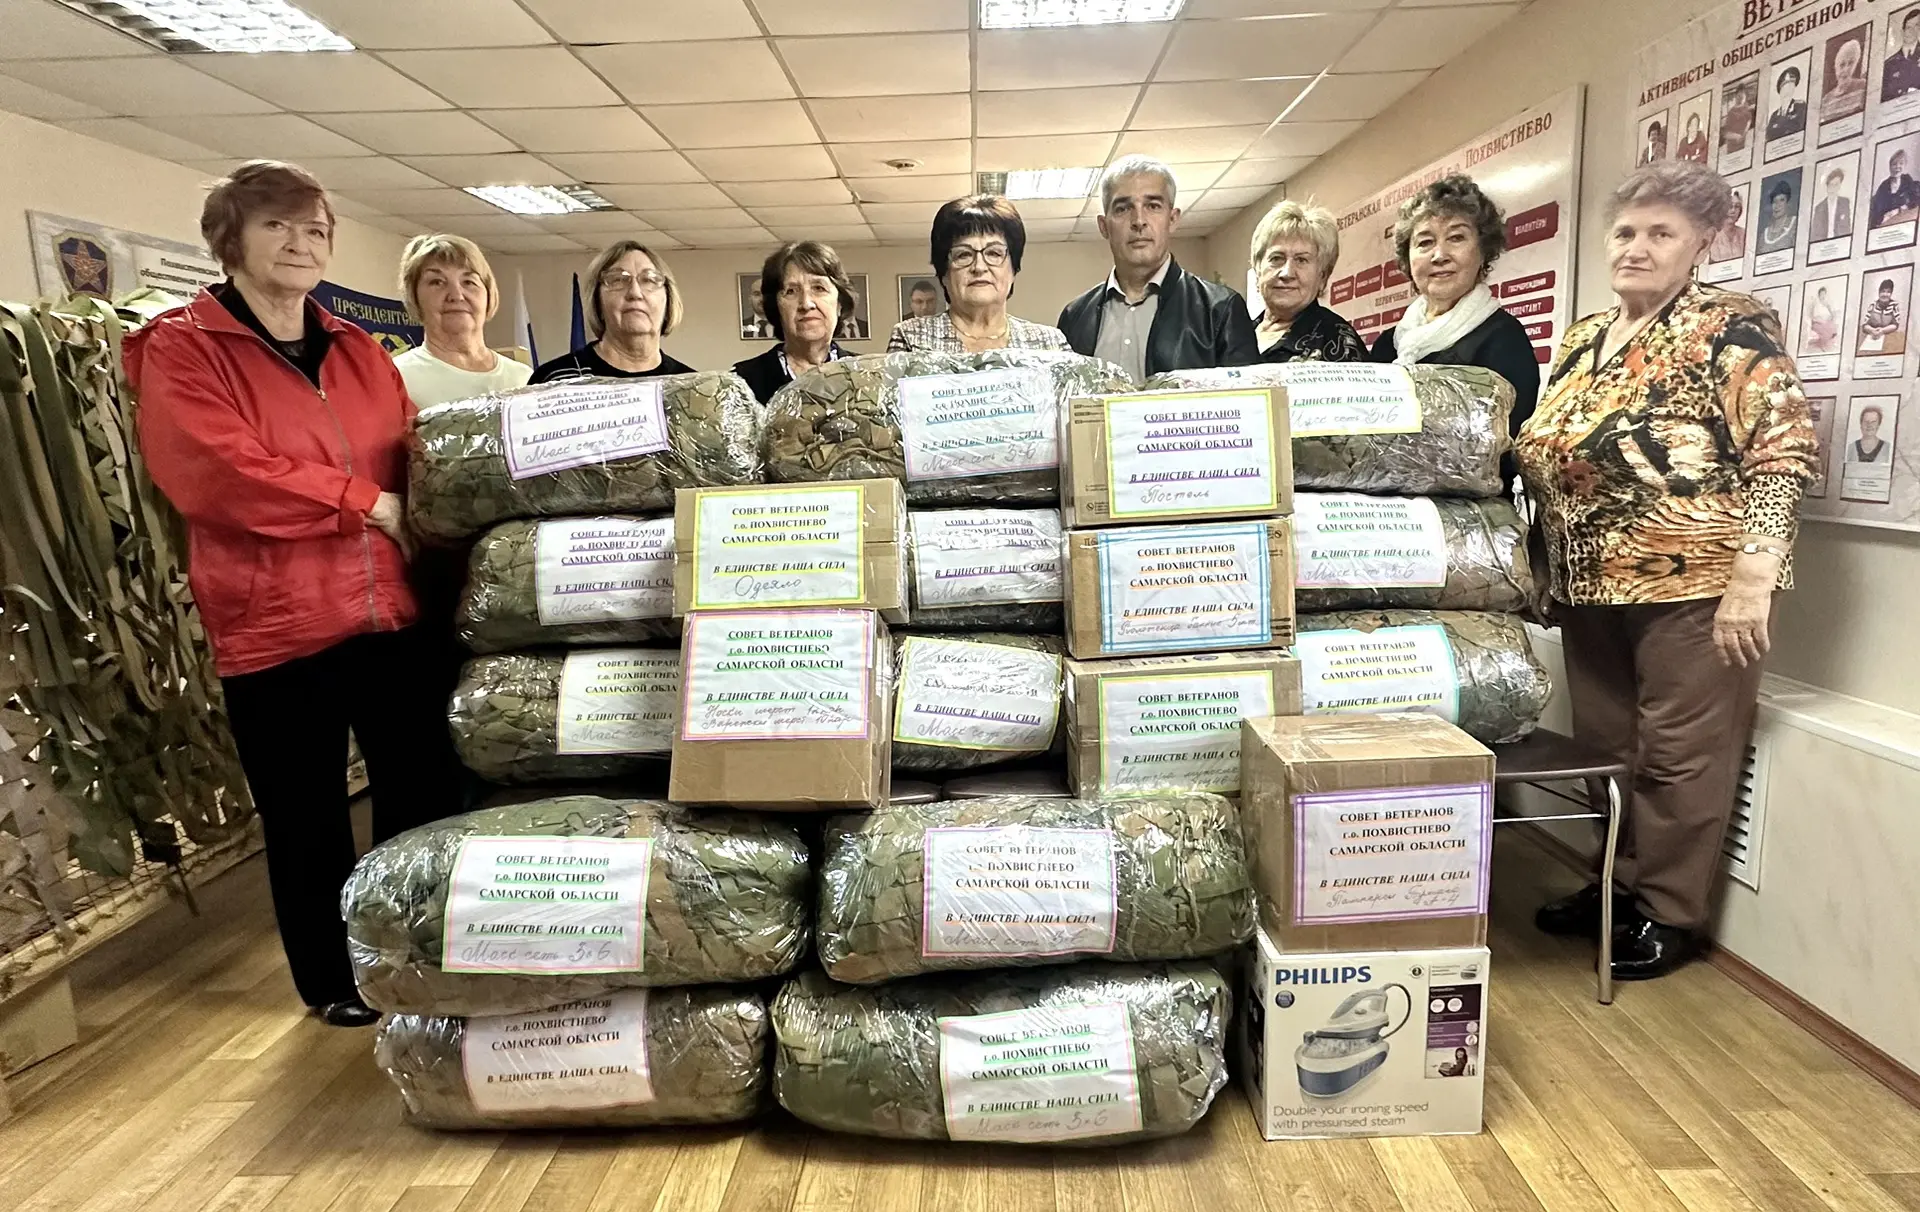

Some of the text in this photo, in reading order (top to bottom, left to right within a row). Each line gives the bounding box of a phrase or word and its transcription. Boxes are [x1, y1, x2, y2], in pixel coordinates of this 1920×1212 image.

[1639, 0, 1855, 106] АКТИВИСТЫ ОБЩЕСТВЕННОЙ
[1465, 112, 1552, 168] ПОХВИСТНЕВО
[926, 409, 986, 423] САМАРСКОЙ
[1144, 410, 1241, 422] СОВЕТ ВЕТЕРАНОВ
[522, 437, 527, 445] В
[533, 426, 583, 442] ЕДИНСТВЕ
[622, 415, 647, 426] СИЛА
[1164, 424, 1239, 435] ПОХВИСТНЕВО
[1137, 438, 1253, 452] САМАРСКОЙ ОБЛАСТИ
[1131, 467, 1260, 482] В ЕДИНСТВЕ НАША СИЛА
[732, 505, 829, 516] СОВЕТ ВЕТЕРАНОВ
[750, 519, 826, 528] ПОХВИСТНЕВО
[1317, 522, 1374, 531] САМАРСКОЙ
[722, 532, 840, 544] САМАРСКОЙ ОБЛАСТИ
[1137, 544, 1235, 557] СОВЕТ ВЕТЕРАНОВ
[1311, 550, 1317, 558] В
[561, 553, 624, 564] САМАРСКОЙ
[1157, 559, 1233, 570] ПОХВИСТНЕВО
[725, 563, 778, 573] ЕДИНСТВЕ
[782, 562, 813, 570] НАША
[819, 561, 846, 569] СИЛА
[1130, 573, 1247, 587] САМАРСКОЙ ОБЛАСТИ
[566, 582, 616, 591] ЕДИНСТВЕ
[735, 575, 802, 599] Одеяло
[1123, 609, 1130, 617] В
[1135, 606, 1187, 616] ЕДИНСТВЕ
[1192, 604, 1222, 613] НАША
[728, 629, 833, 639] СОВЕТ ВЕТЕРАНОВ
[747, 644, 830, 653] ПОХВИСТНЕВО
[597, 660, 629, 668] СОВЕТ
[717, 659, 843, 670] САМАРСКОЙ ОБЛАСТИ
[1322, 666, 1433, 680] САМАРСКОЙ ОБЛАСТИ
[585, 684, 646, 693] САМАРСКОЙ
[718, 692, 775, 701] ЕДИНСТВЕ
[780, 691, 813, 700] НАША
[819, 691, 849, 700] СИЛА
[1138, 691, 1239, 703] СОВЕТ ВЕТЕРАНОВ
[1327, 698, 1378, 708] ЕДИНСТВЕ
[1383, 695, 1412, 703] НАША
[1417, 693, 1443, 701] СИЛА
[587, 713, 640, 721] ЕДИНСТВЕ
[926, 704, 977, 716] ЕДИНСТВЕ
[982, 710, 1011, 720] НАША
[1016, 713, 1041, 724] СИЛА
[1158, 706, 1237, 717] ПОХВИСТНЕВО
[1130, 721, 1242, 734] САМАРСКОЙ ОБЛАСТ
[1122, 751, 1225, 764] В ЕДИНСТВЕ НАША
[1339, 807, 1454, 823] СОВЕТ ВЕТЕРАНОВ
[1343, 824, 1451, 839] г.о. ПОХВИСТНЕВО
[1330, 839, 1465, 856] САМАРСКОЙ ОБЛАСТИ
[496, 855, 610, 866] СОВЕТ ВЕТЕРАНОВ
[514, 872, 605, 883] ПОХВИСТНЕВО
[956, 878, 1090, 889] САМАРСКОЙ ОБЛАСТИ
[1320, 871, 1470, 888] В ЕДИНСТВЕ НАША СИЛА
[479, 888, 618, 900] САМАРСКОЙ ОБЛАСТИ
[946, 914, 953, 922] В
[1025, 915, 1060, 923] НАША
[1066, 915, 1096, 923] СИЛА
[467, 924, 623, 934] В ЕДИНСТВЕ НАША СИЛА
[1275, 966, 1372, 985] PHILIPS
[523, 1016, 606, 1031] ПОХВИСТНЕВО
[492, 1032, 620, 1050] САМАРСКОЙ ОБЛАСТИ
[1003, 1042, 1091, 1060] ПОХВИСТНЕВО
[487, 1065, 628, 1083] В ЕДИНСТВЕ НАША СИЛА
[972, 1059, 1108, 1080] САМАРСКОЙ ОБЛАСТИ
[967, 1093, 1119, 1113] В ЕДИНСТВЕ НАША СИЛА
[1273, 1102, 1429, 1116] Double your ironing speed
[1273, 1119, 1298, 1129] with
[1371, 1118, 1405, 1126] steam
